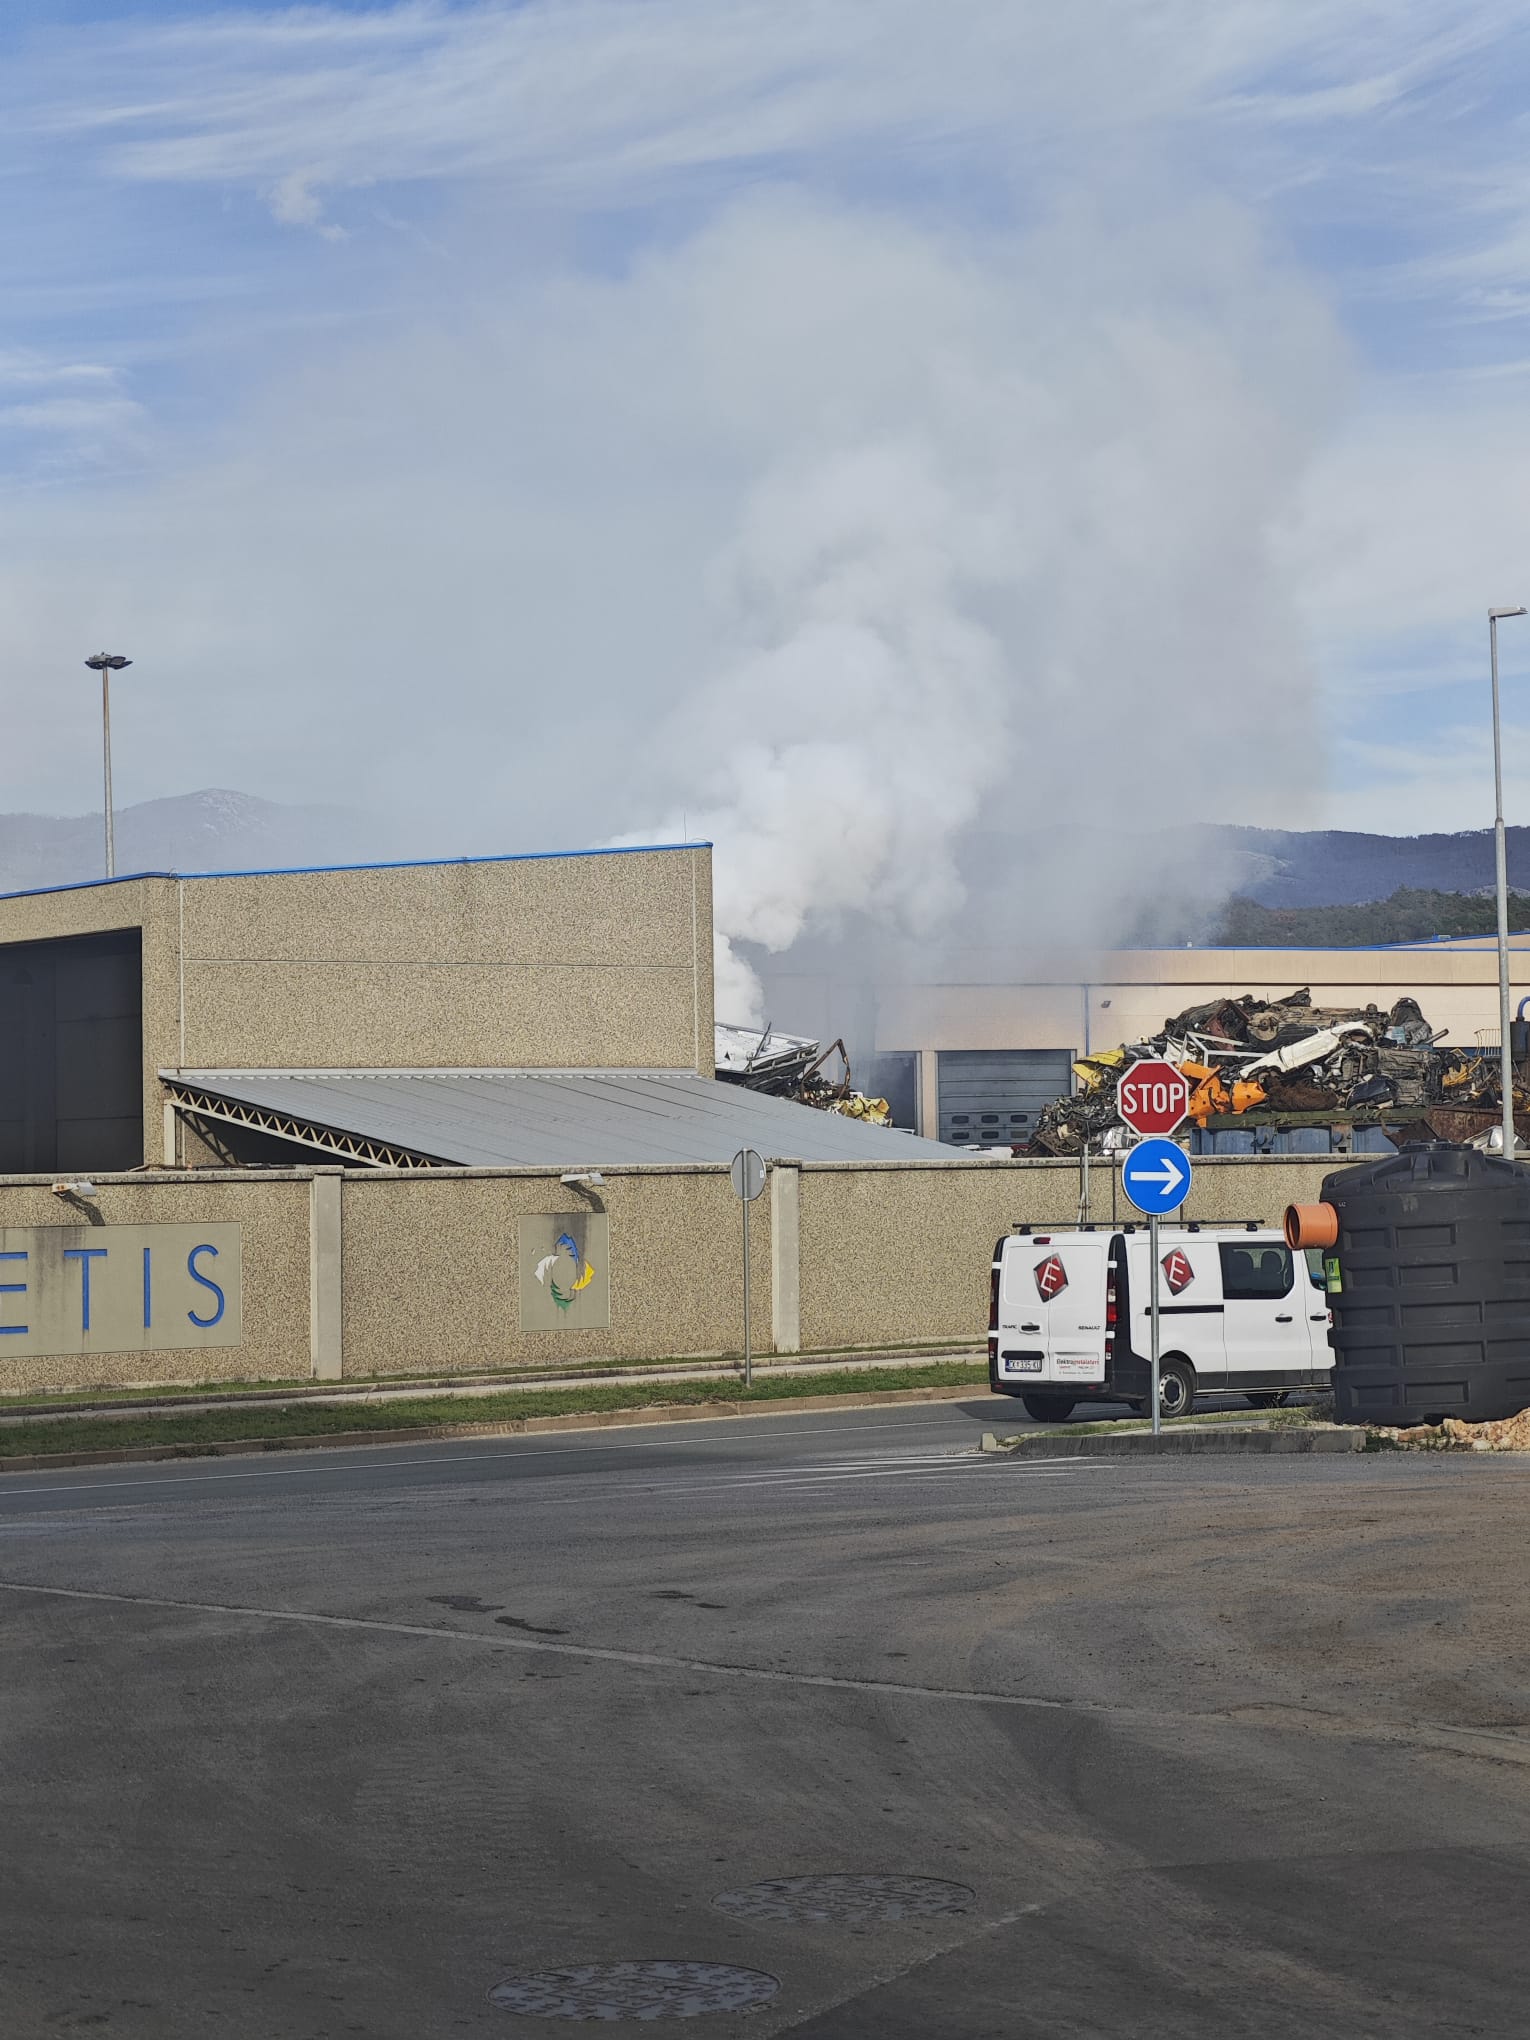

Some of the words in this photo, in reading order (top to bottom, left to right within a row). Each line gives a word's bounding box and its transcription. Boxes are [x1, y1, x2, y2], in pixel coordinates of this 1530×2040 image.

[1123, 1082, 1184, 1114] STOP
[1040, 1262, 1060, 1293] E
[1169, 1255, 1186, 1286] E
[0, 1244, 225, 1334] ETIS
